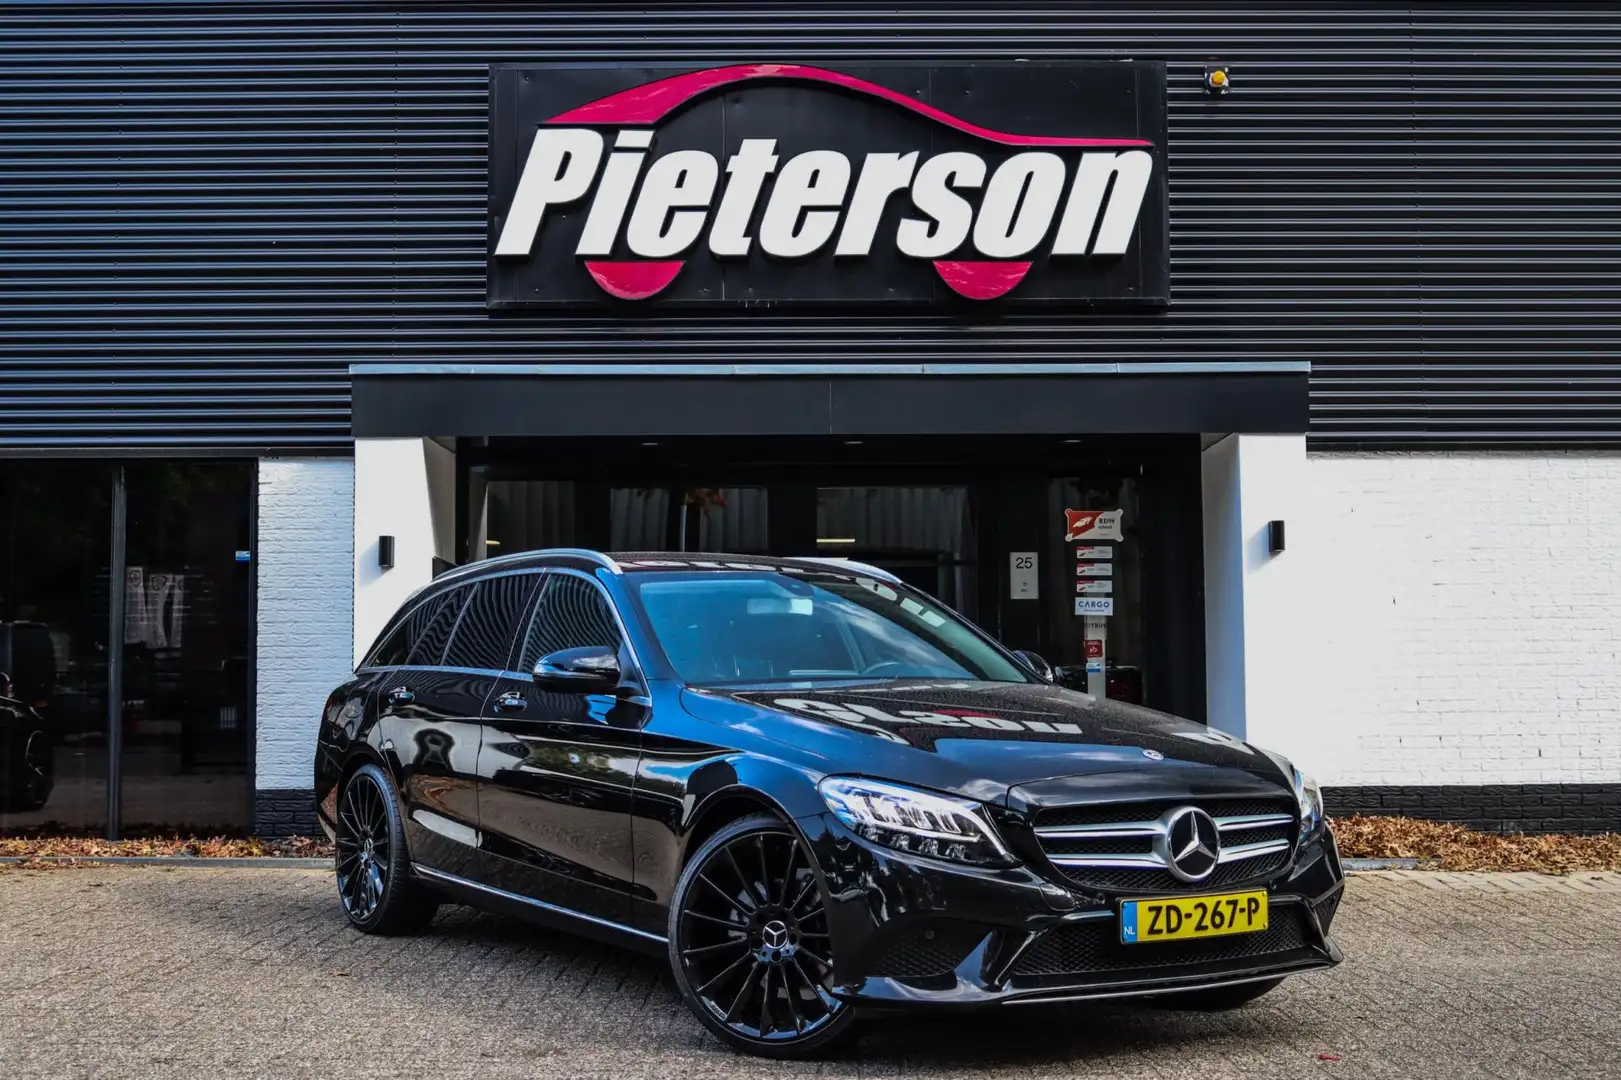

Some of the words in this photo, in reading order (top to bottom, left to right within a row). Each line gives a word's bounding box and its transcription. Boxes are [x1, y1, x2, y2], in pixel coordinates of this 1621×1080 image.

[494, 127, 1154, 258] Pieterson
[1016, 557, 1033, 569] 25
[1078, 600, 1110, 608] CARGO
[1147, 897, 1260, 936] ZD-267-P
[1123, 926, 1136, 936] NL
